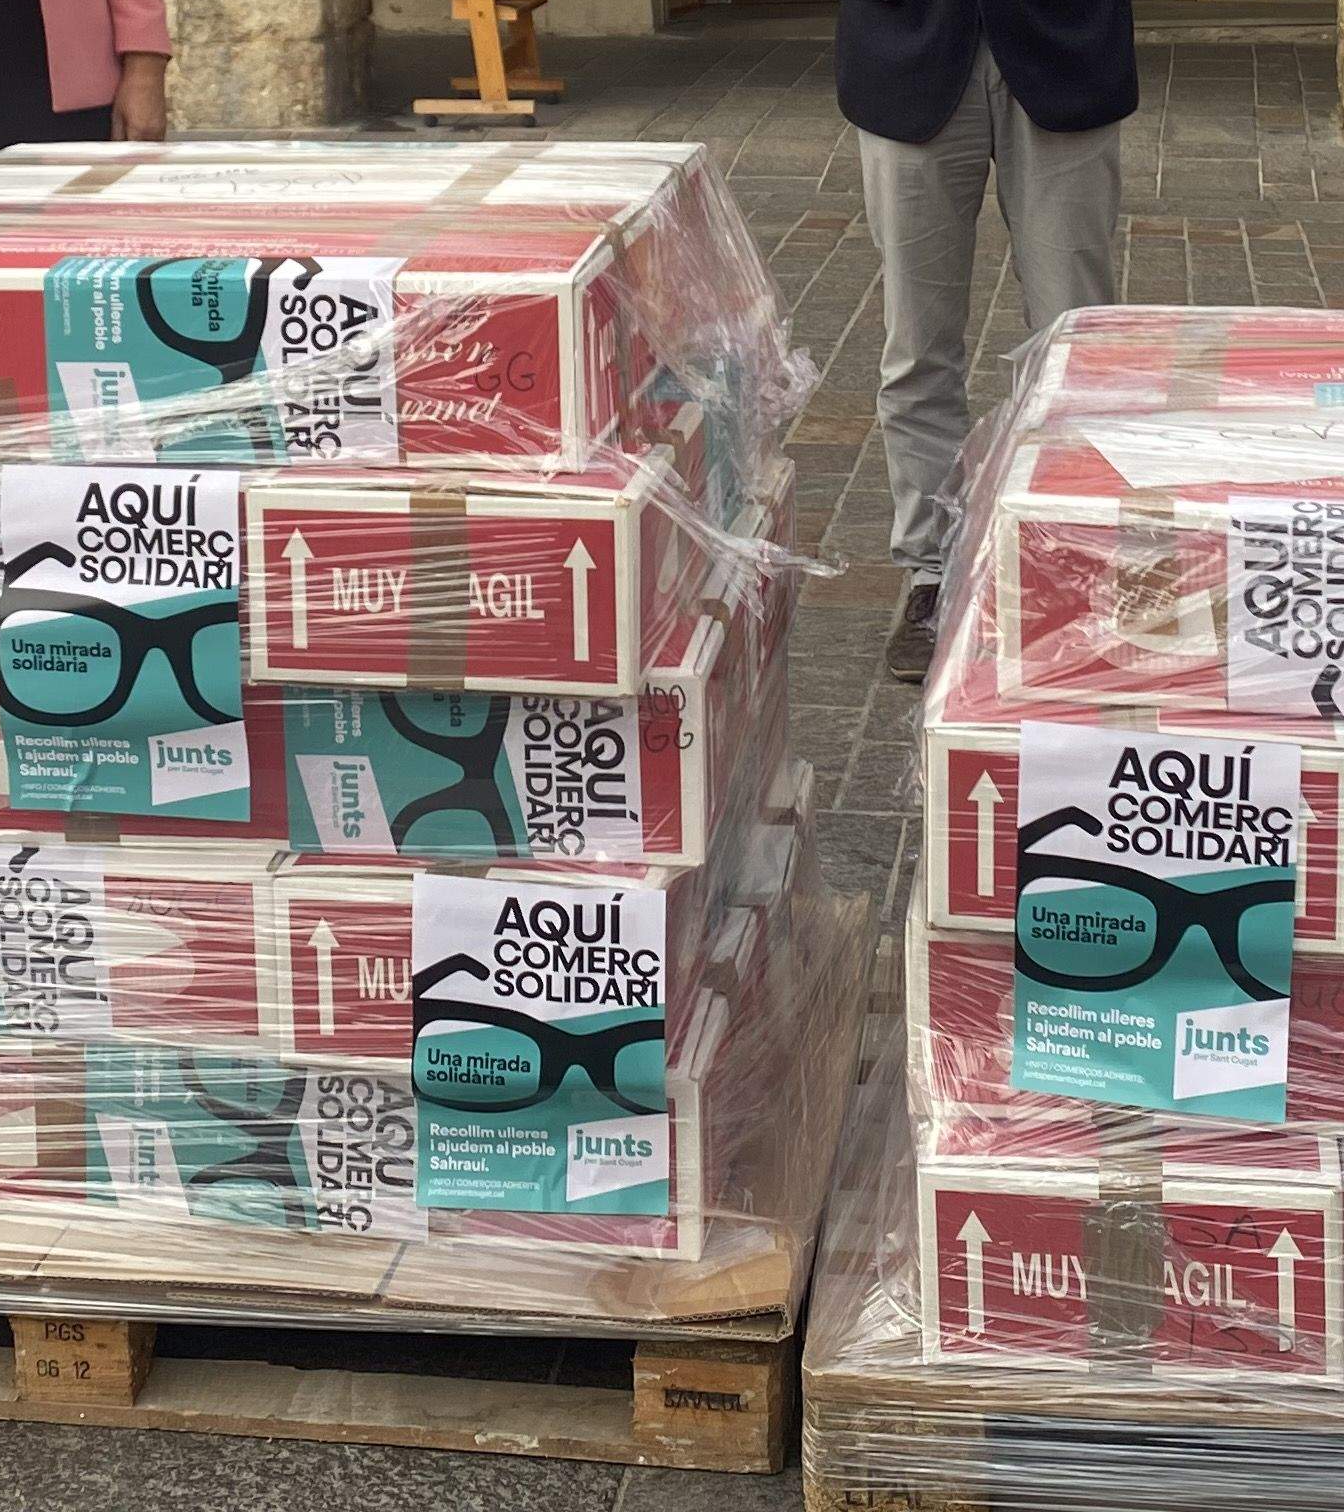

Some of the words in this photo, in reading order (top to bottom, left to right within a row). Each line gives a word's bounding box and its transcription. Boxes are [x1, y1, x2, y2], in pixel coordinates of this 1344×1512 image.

[76, 474, 201, 529] AQUÍ
[77, 526, 234, 566] COMERÇ
[79, 555, 232, 589] SOLIDARI
[332, 568, 406, 612] MUY
[468, 573, 544, 618] AGIL
[1232, 519, 1292, 659] AQUÍ
[11, 639, 45, 655] Una
[50, 641, 112, 658] mirada
[12, 656, 87, 673] solidària
[15, 735, 78, 749] Recollim
[81, 737, 130, 749] ulleres
[156, 740, 232, 768] junts
[25, 751, 79, 764] ajudem
[82, 751, 93, 762] al
[97, 752, 139, 766] poble
[580, 699, 639, 823] AQUÍ
[1109, 746, 1255, 800] AQUÍ
[1108, 793, 1293, 841] COMERÇ
[1107, 824, 1289, 867] SOLIDARI
[494, 893, 624, 947] AQUÍ
[1032, 906, 1070, 925] Una
[1075, 912, 1146, 932] mirada
[1031, 925, 1117, 945] solidària
[494, 939, 660, 986] COMERÇ
[358, 955, 410, 1001] MU
[494, 969, 658, 1007] SOLIDARI
[1027, 1001, 1097, 1023] Recollim
[1100, 1008, 1155, 1029] ulleres
[1027, 1037, 1089, 1059] Sahrauí.
[1035, 1020, 1094, 1040] ajudem
[1097, 1027, 1111, 1043] al
[1115, 1030, 1162, 1050] poble
[1182, 1019, 1270, 1056] junts
[427, 1047, 462, 1066] Una
[467, 1052, 531, 1073] mirada
[427, 1067, 506, 1086] solidària
[430, 1123, 495, 1138] Recollim
[498, 1125, 548, 1139] ulleres
[573, 1130, 652, 1161] junts
[430, 1157, 489, 1172] Sahrauí.
[438, 1141, 493, 1156] ajudem
[496, 1142, 508, 1155] al
[512, 1143, 555, 1158] poble
[1012, 1252, 1087, 1300] MUY
[1163, 1260, 1246, 1308] AGIL
[72, 1360, 91, 1380] 12
